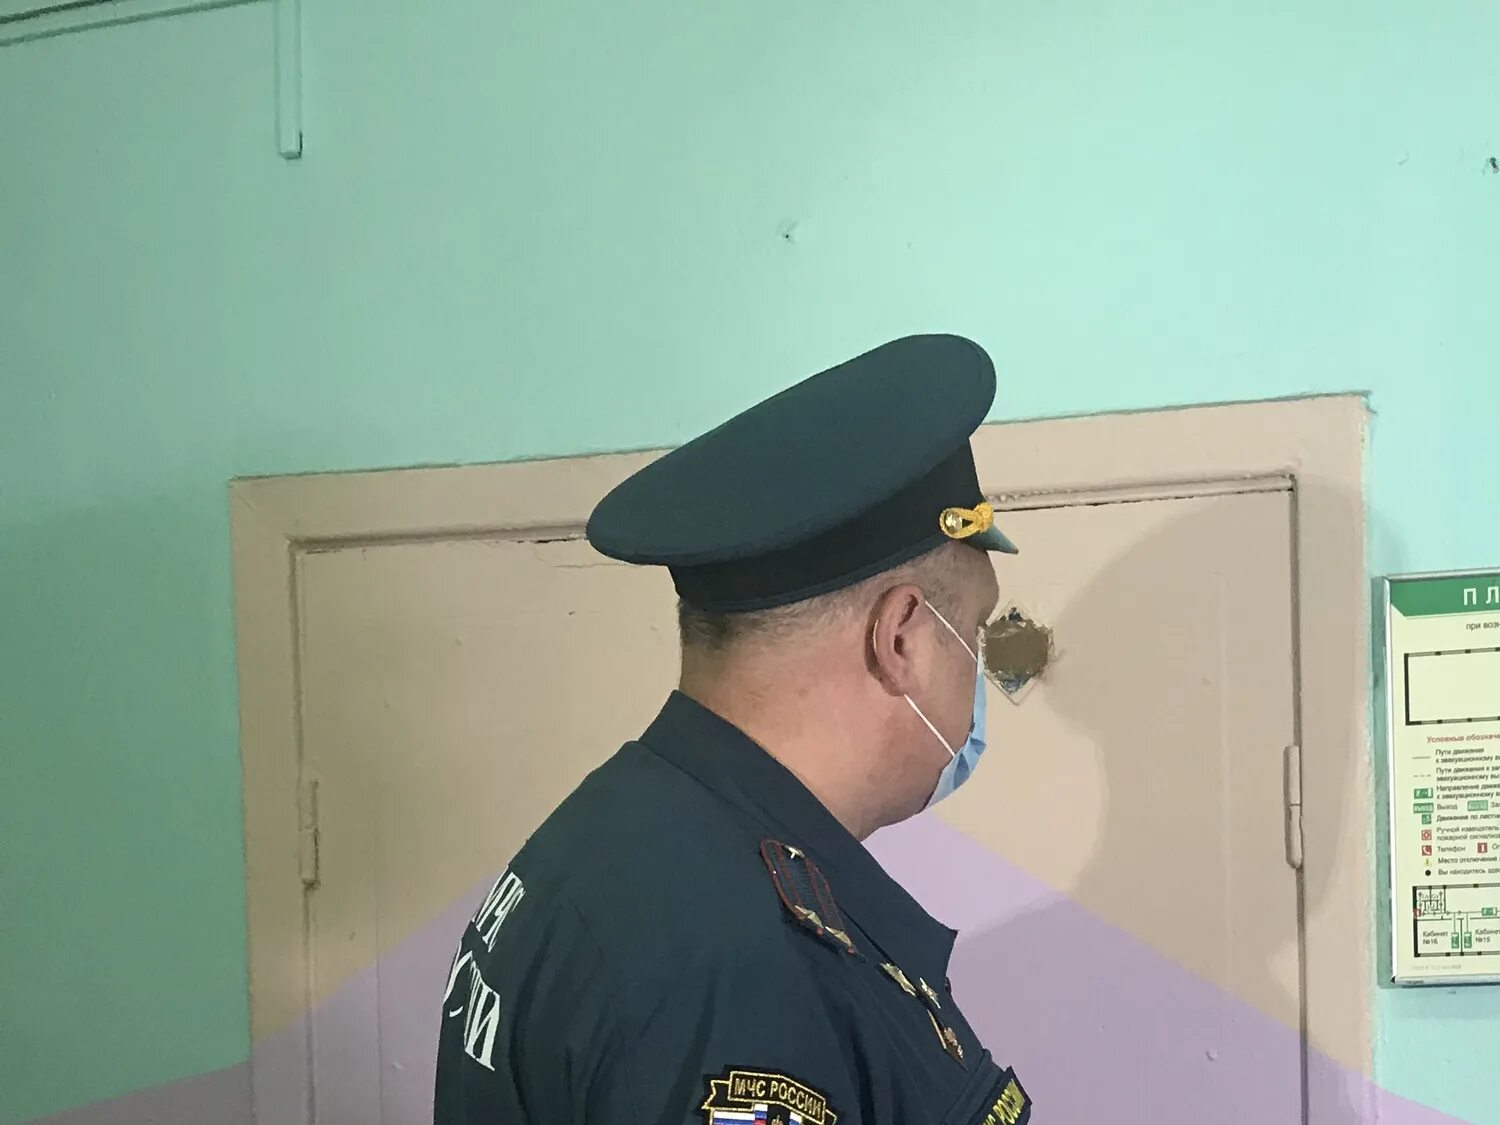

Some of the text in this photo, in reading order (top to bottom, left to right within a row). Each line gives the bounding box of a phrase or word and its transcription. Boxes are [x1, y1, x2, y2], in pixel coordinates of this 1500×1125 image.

[1466, 621, 1481, 630] при
[1426, 734, 1464, 743] Условные
[1440, 755, 1492, 764] эвакуационному
[1453, 765, 1484, 773] движения
[1436, 773, 1488, 782] эвакуационному
[1436, 783, 1479, 792] Направления
[1441, 791, 1493, 800] эвакуационному
[1436, 814, 1468, 822] Движение
[1459, 855, 1497, 863] отключения
[734, 1078, 821, 1118] МЧС РОССИИ
